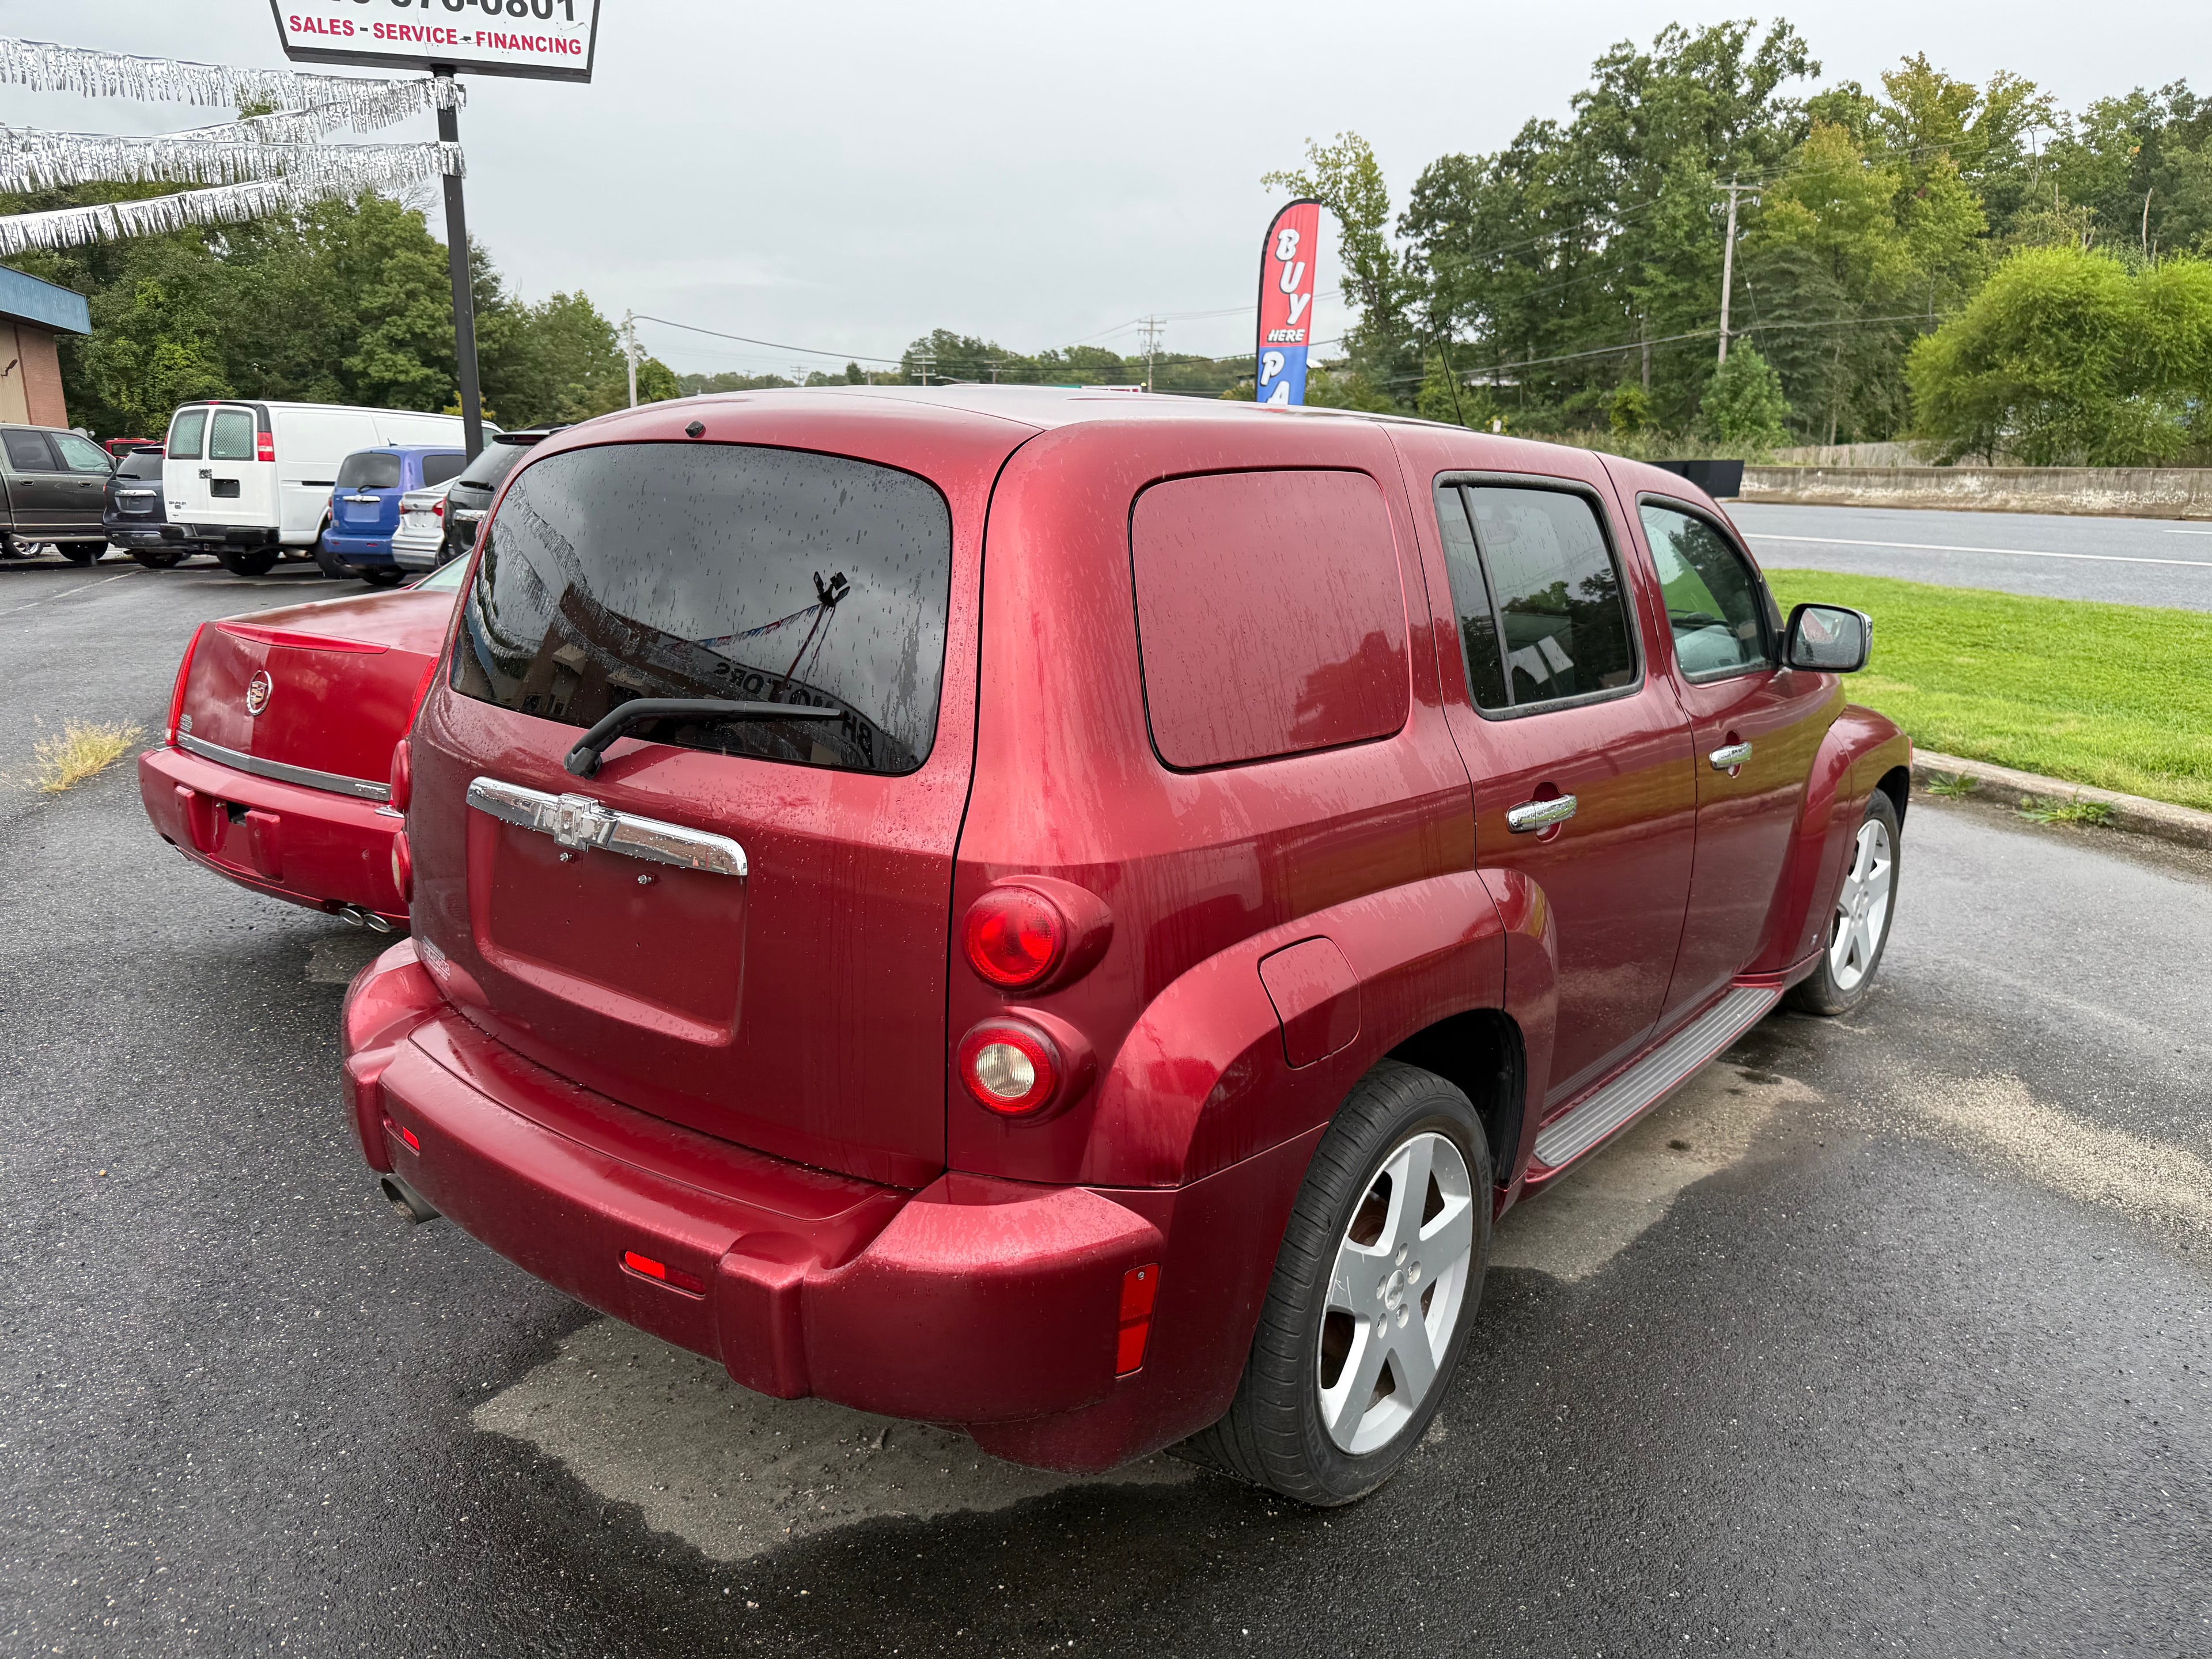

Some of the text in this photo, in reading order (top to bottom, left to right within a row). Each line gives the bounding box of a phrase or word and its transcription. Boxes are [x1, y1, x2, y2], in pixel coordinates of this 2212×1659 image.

[289, 15, 355, 36] SALES
[373, 22, 458, 45] SERVICE
[476, 31, 581, 55] FINANCING
[1275, 228, 1311, 326] BUY
[1267, 328, 1306, 343] HERE
